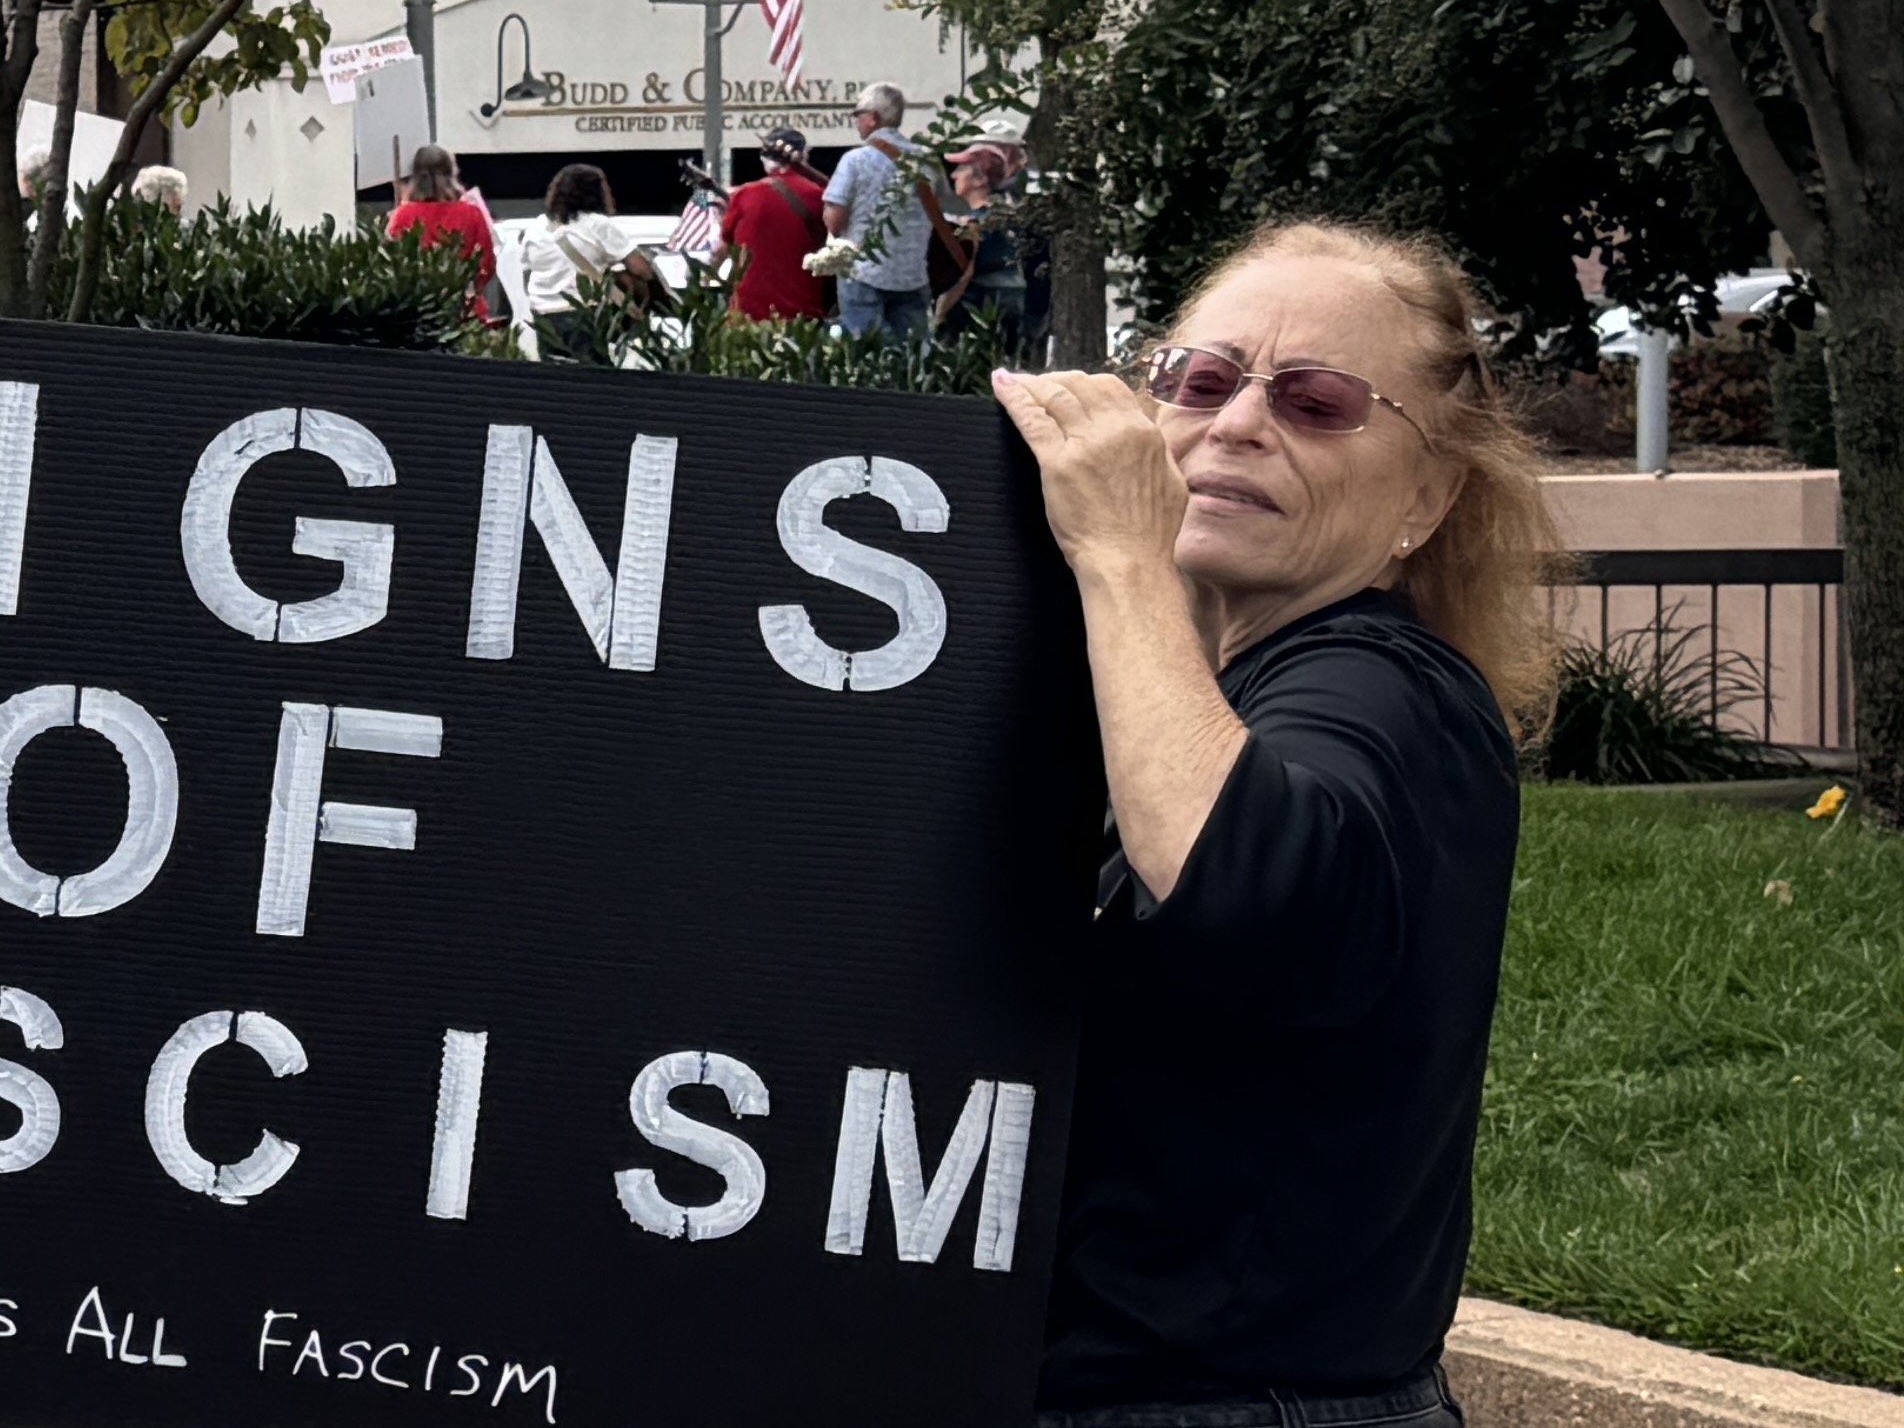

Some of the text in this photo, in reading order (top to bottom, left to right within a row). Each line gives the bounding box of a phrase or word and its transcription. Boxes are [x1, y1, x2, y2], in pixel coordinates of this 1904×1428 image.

[542, 71, 629, 106] BUDD
[642, 71, 672, 105] &
[575, 115, 667, 132] CERTIFIED
[741, 112, 855, 130] ACCOUNTANT
